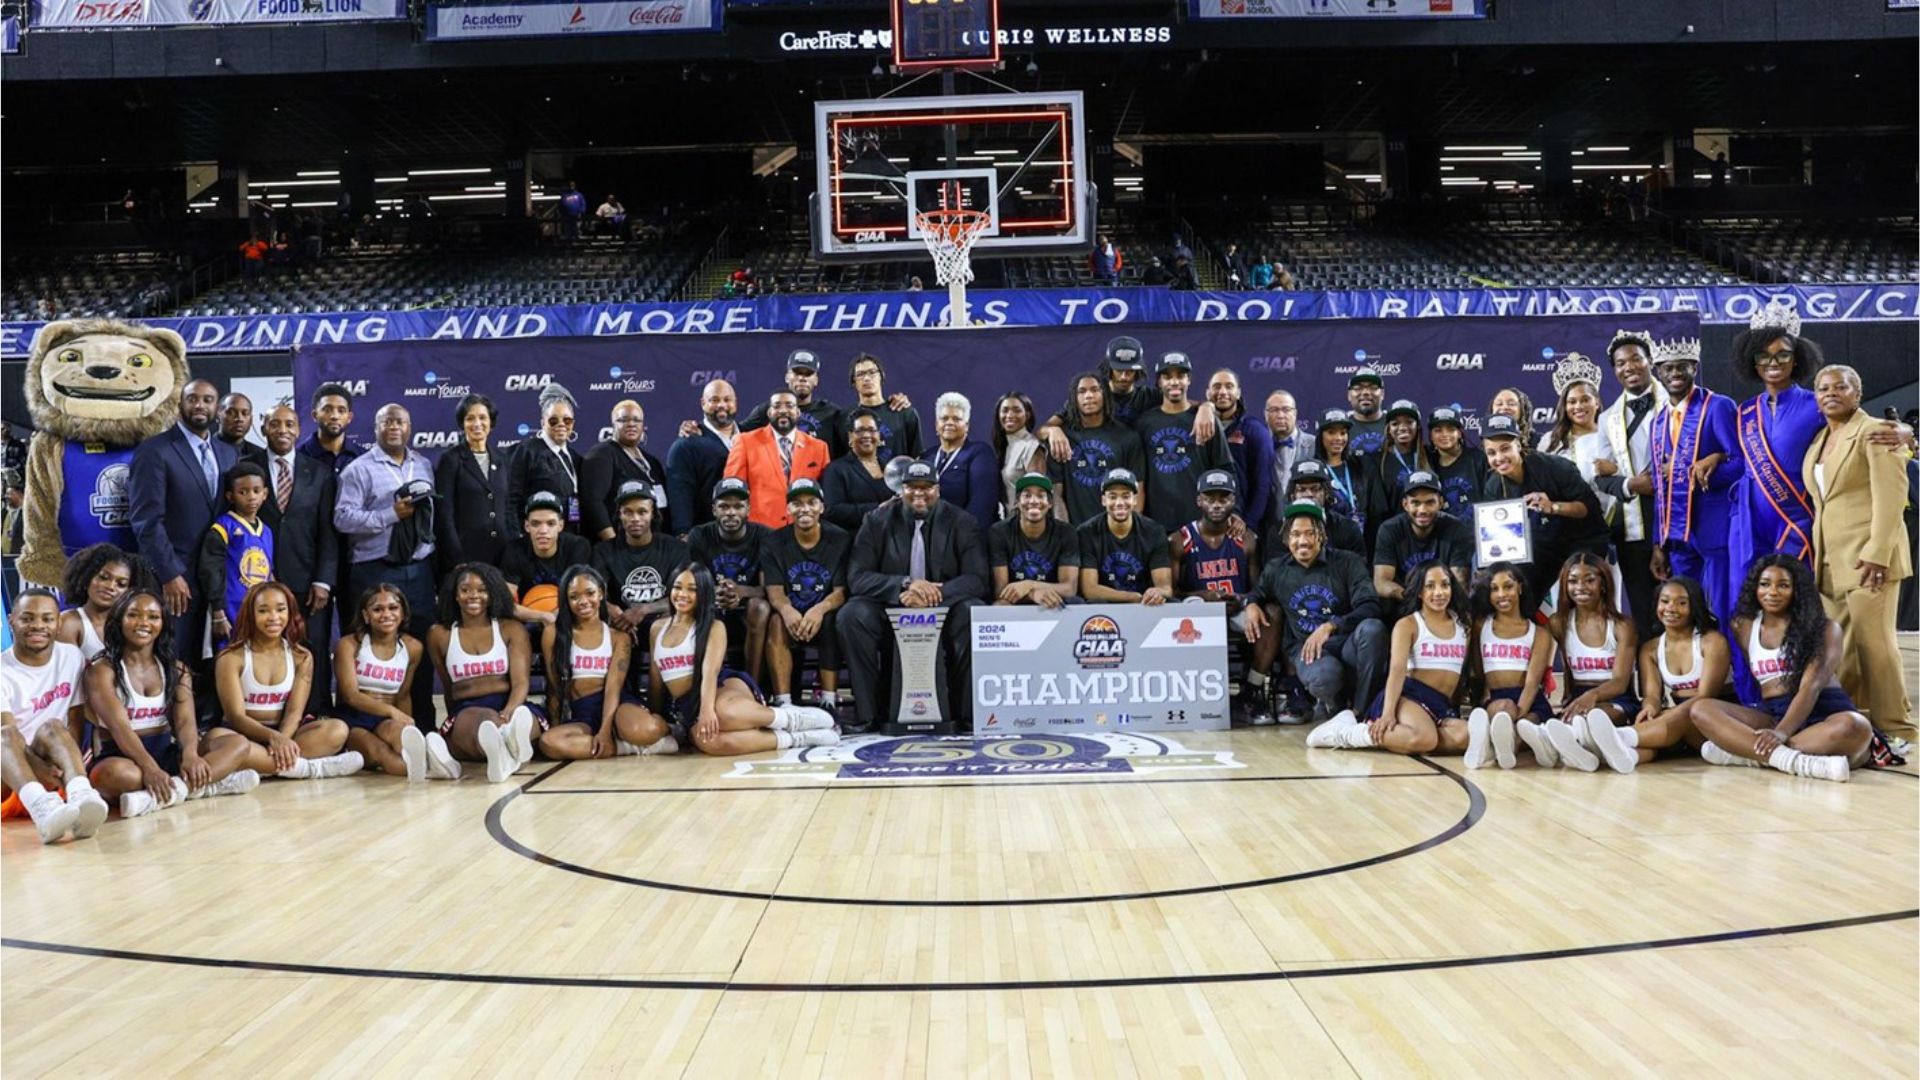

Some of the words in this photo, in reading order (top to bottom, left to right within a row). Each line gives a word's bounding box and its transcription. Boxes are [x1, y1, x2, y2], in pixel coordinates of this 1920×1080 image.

[258, 0, 299, 14] FOOD
[326, 0, 361, 13] LION
[462, 13, 523, 27] Academy
[1045, 27, 1171, 44] WELLNESS
[854, 231, 886, 243] CIAA
[192, 317, 389, 347] DINING
[432, 313, 548, 339] AND
[593, 307, 753, 336] MORE
[1060, 298, 1129, 324] TO
[1195, 299, 1295, 321] DO!
[1250, 356, 1297, 372] CIAA
[1436, 353, 1484, 371] CIAA
[1522, 363, 1545, 371] MAKE
[505, 373, 552, 391] CIAA
[622, 377, 655, 393] YOURS
[404, 388, 427, 396] MAKE
[413, 431, 460, 448] CIAA
[621, 587, 663, 602] CIAA
[899, 613, 937, 626] CIAA
[978, 624, 1006, 633] 2024
[1075, 640, 1124, 657] CIAA
[1482, 643, 1532, 660] LIONS
[354, 659, 404, 682] LIONS
[452, 658, 506, 679] LIONS
[977, 668, 1225, 707] CHAMPIONS
[888, 740, 1075, 763] 50
[986, 761, 1109, 773] YOURS
